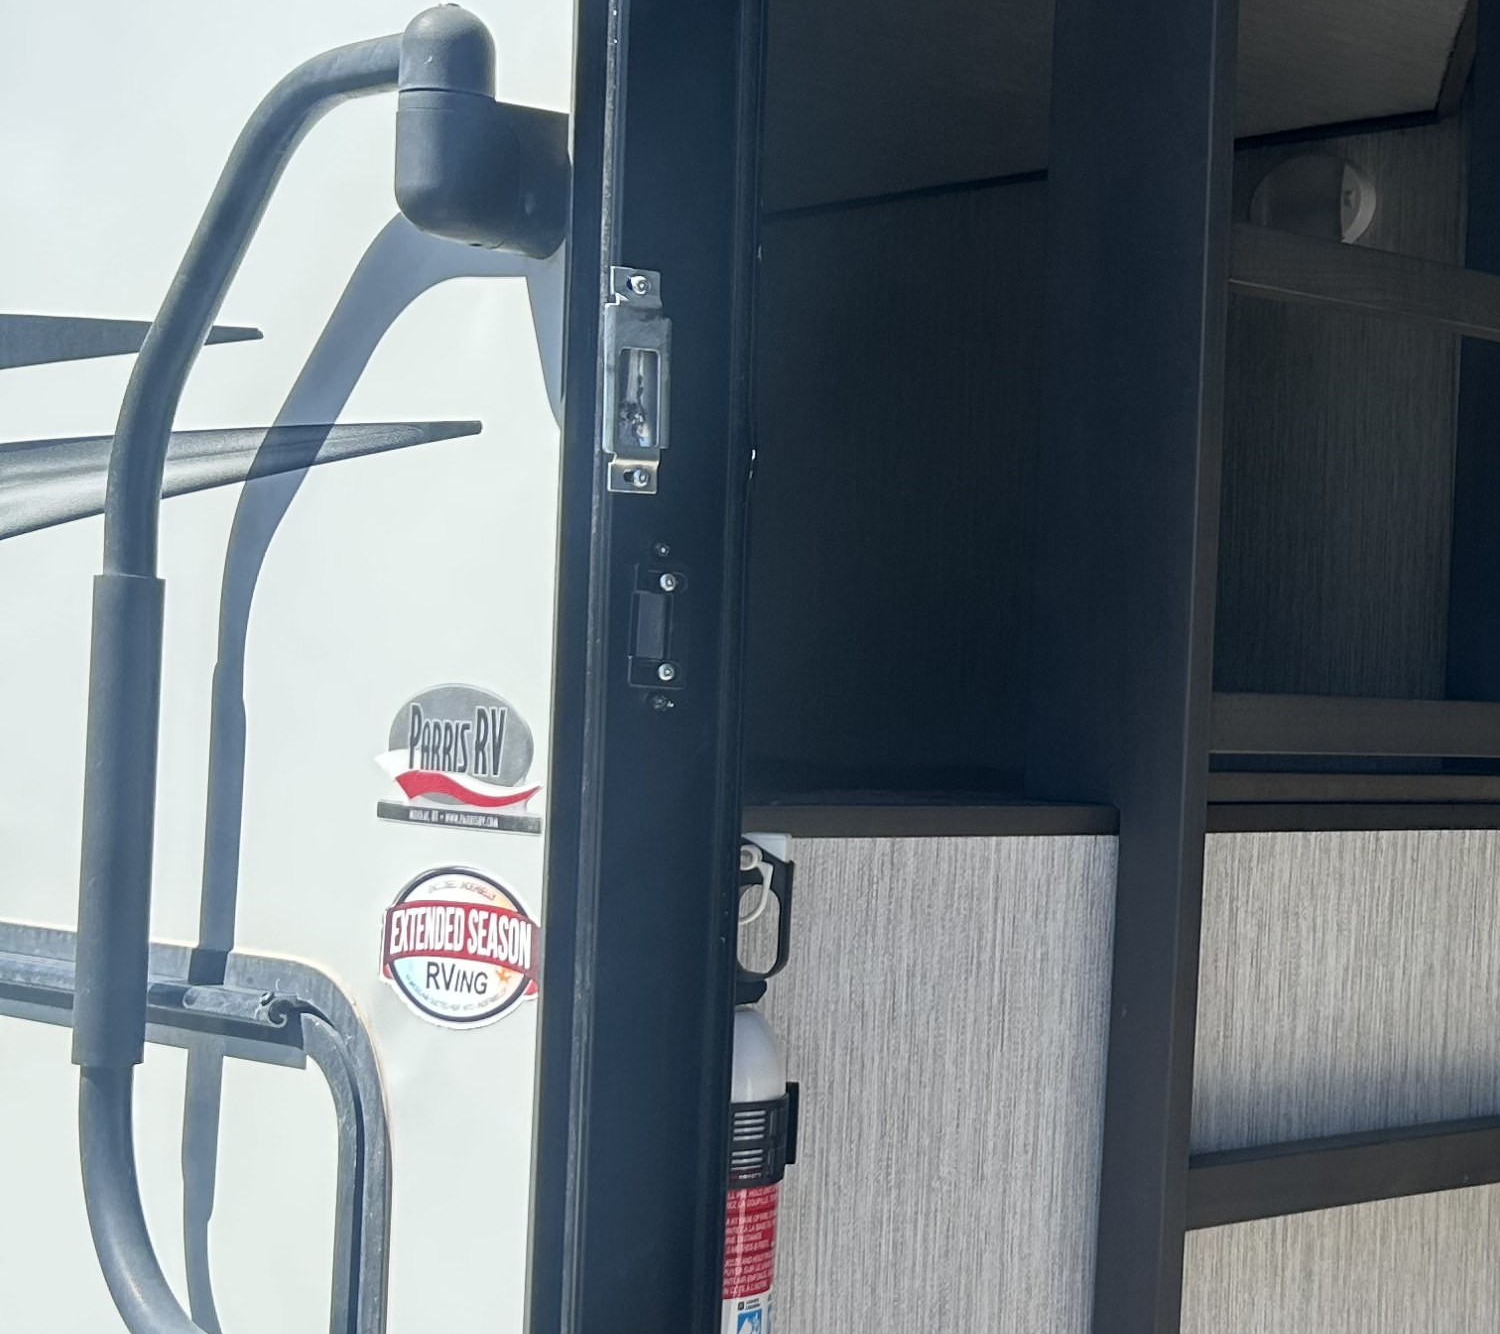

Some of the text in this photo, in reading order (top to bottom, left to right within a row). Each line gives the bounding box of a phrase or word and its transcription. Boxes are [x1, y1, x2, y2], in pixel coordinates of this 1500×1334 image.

[409, 703, 507, 777] PARRIS RV
[389, 906, 532, 970] EXTENDED SEASON
